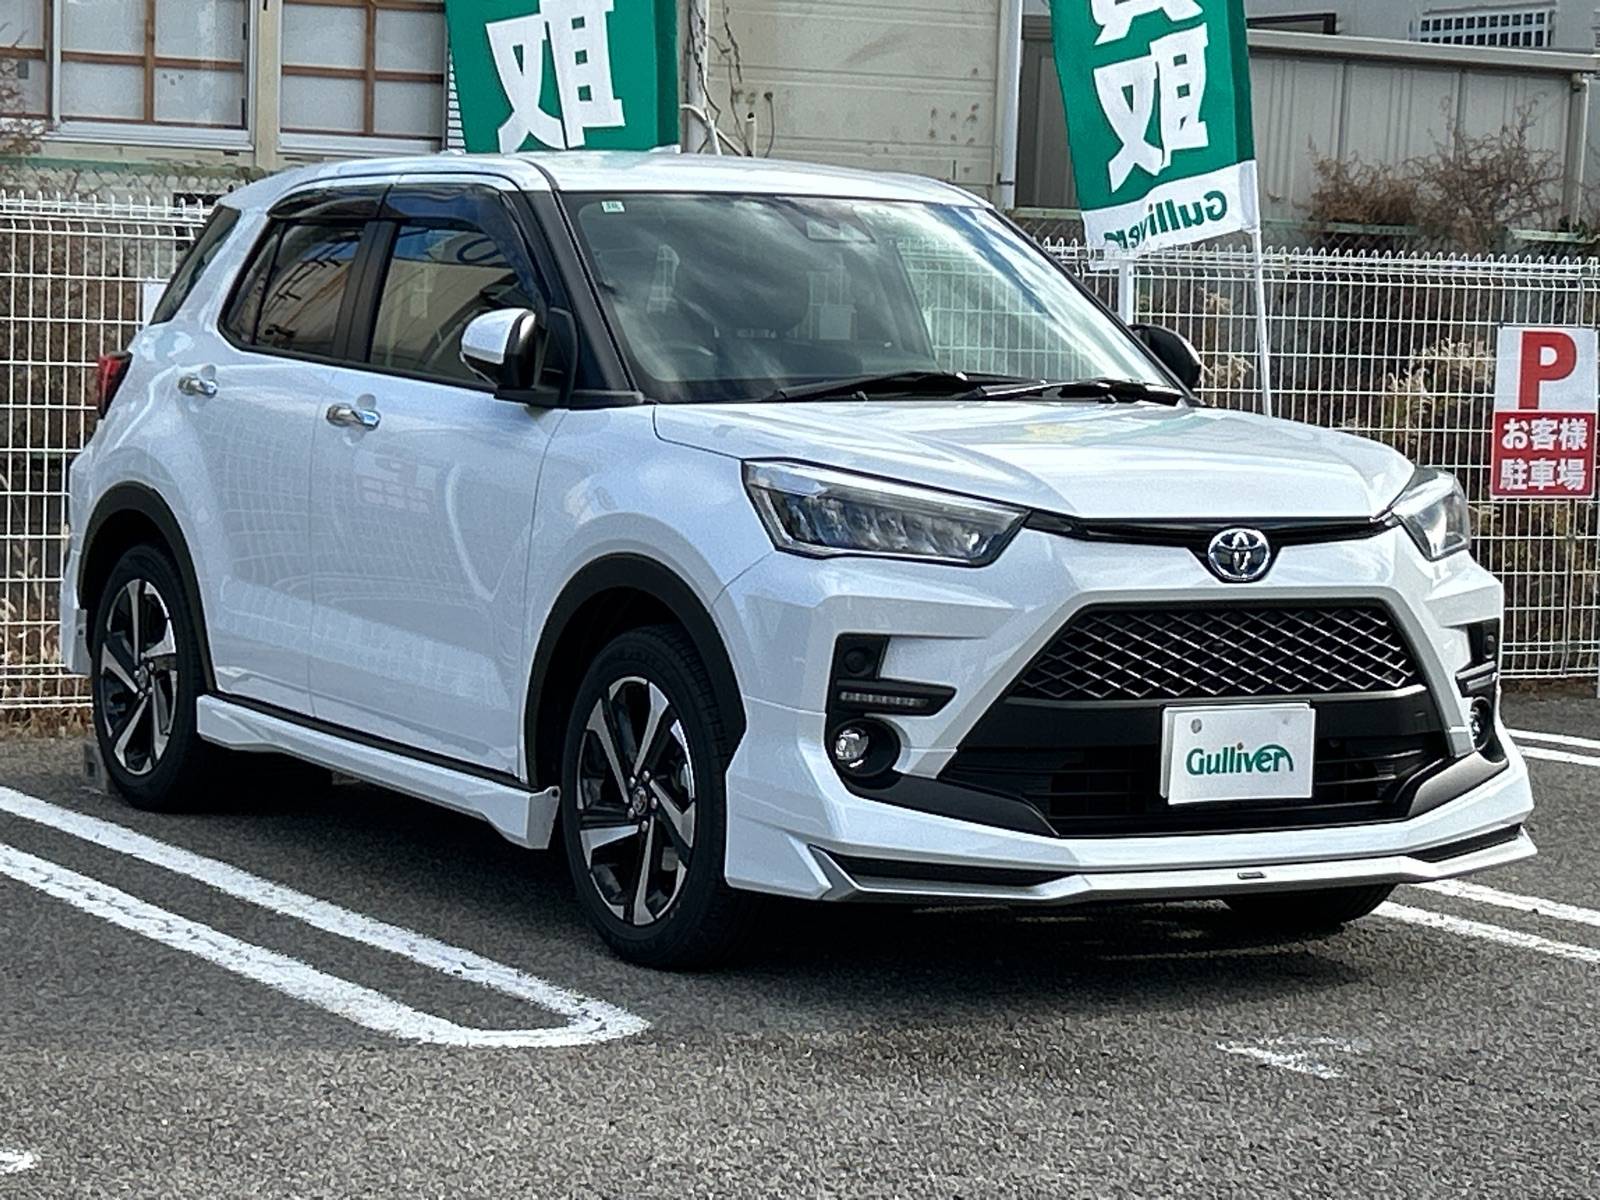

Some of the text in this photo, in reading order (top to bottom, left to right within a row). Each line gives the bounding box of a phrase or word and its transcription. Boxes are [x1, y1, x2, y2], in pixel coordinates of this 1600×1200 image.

[1518, 330, 1577, 410] P
[1501, 417, 1588, 450] お客様
[1499, 457, 1587, 491] 駐車場
[1186, 742, 1294, 775] Gulliver
